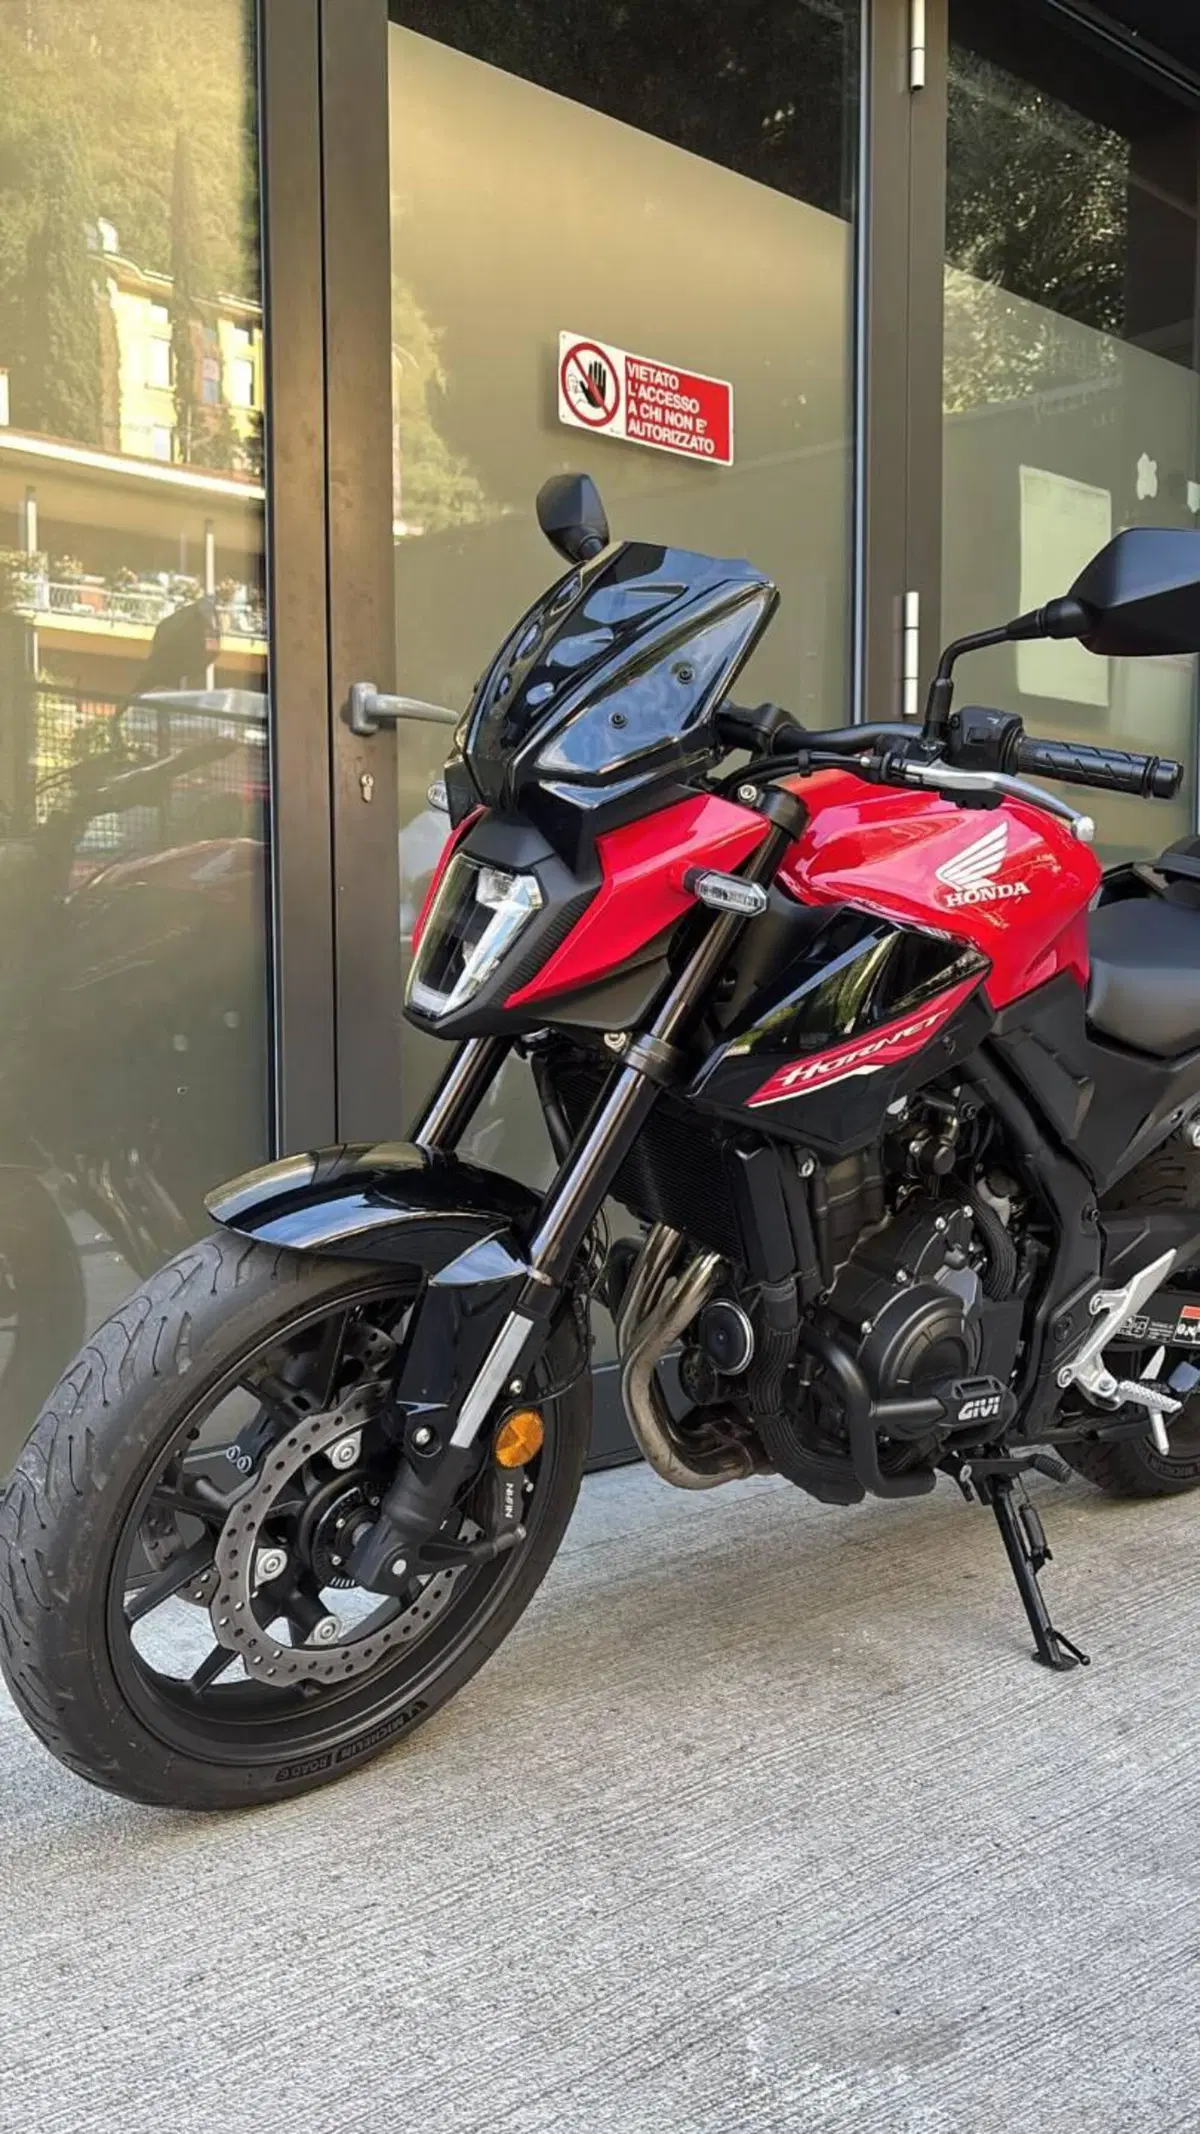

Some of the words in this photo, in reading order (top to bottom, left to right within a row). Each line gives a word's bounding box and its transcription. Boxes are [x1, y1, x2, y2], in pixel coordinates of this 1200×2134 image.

[627, 361, 679, 390] VIETATO
[627, 381, 699, 414] L'ACCESSO
[627, 401, 638, 416] A
[640, 404, 663, 422] CHI
[665, 410, 693, 431] NON
[627, 420, 715, 454] AUTORIZZATO
[945, 881, 1031, 908] HONDA
[775, 1008, 949, 1087] HORNET
[958, 1396, 1001, 1421] GIVI
